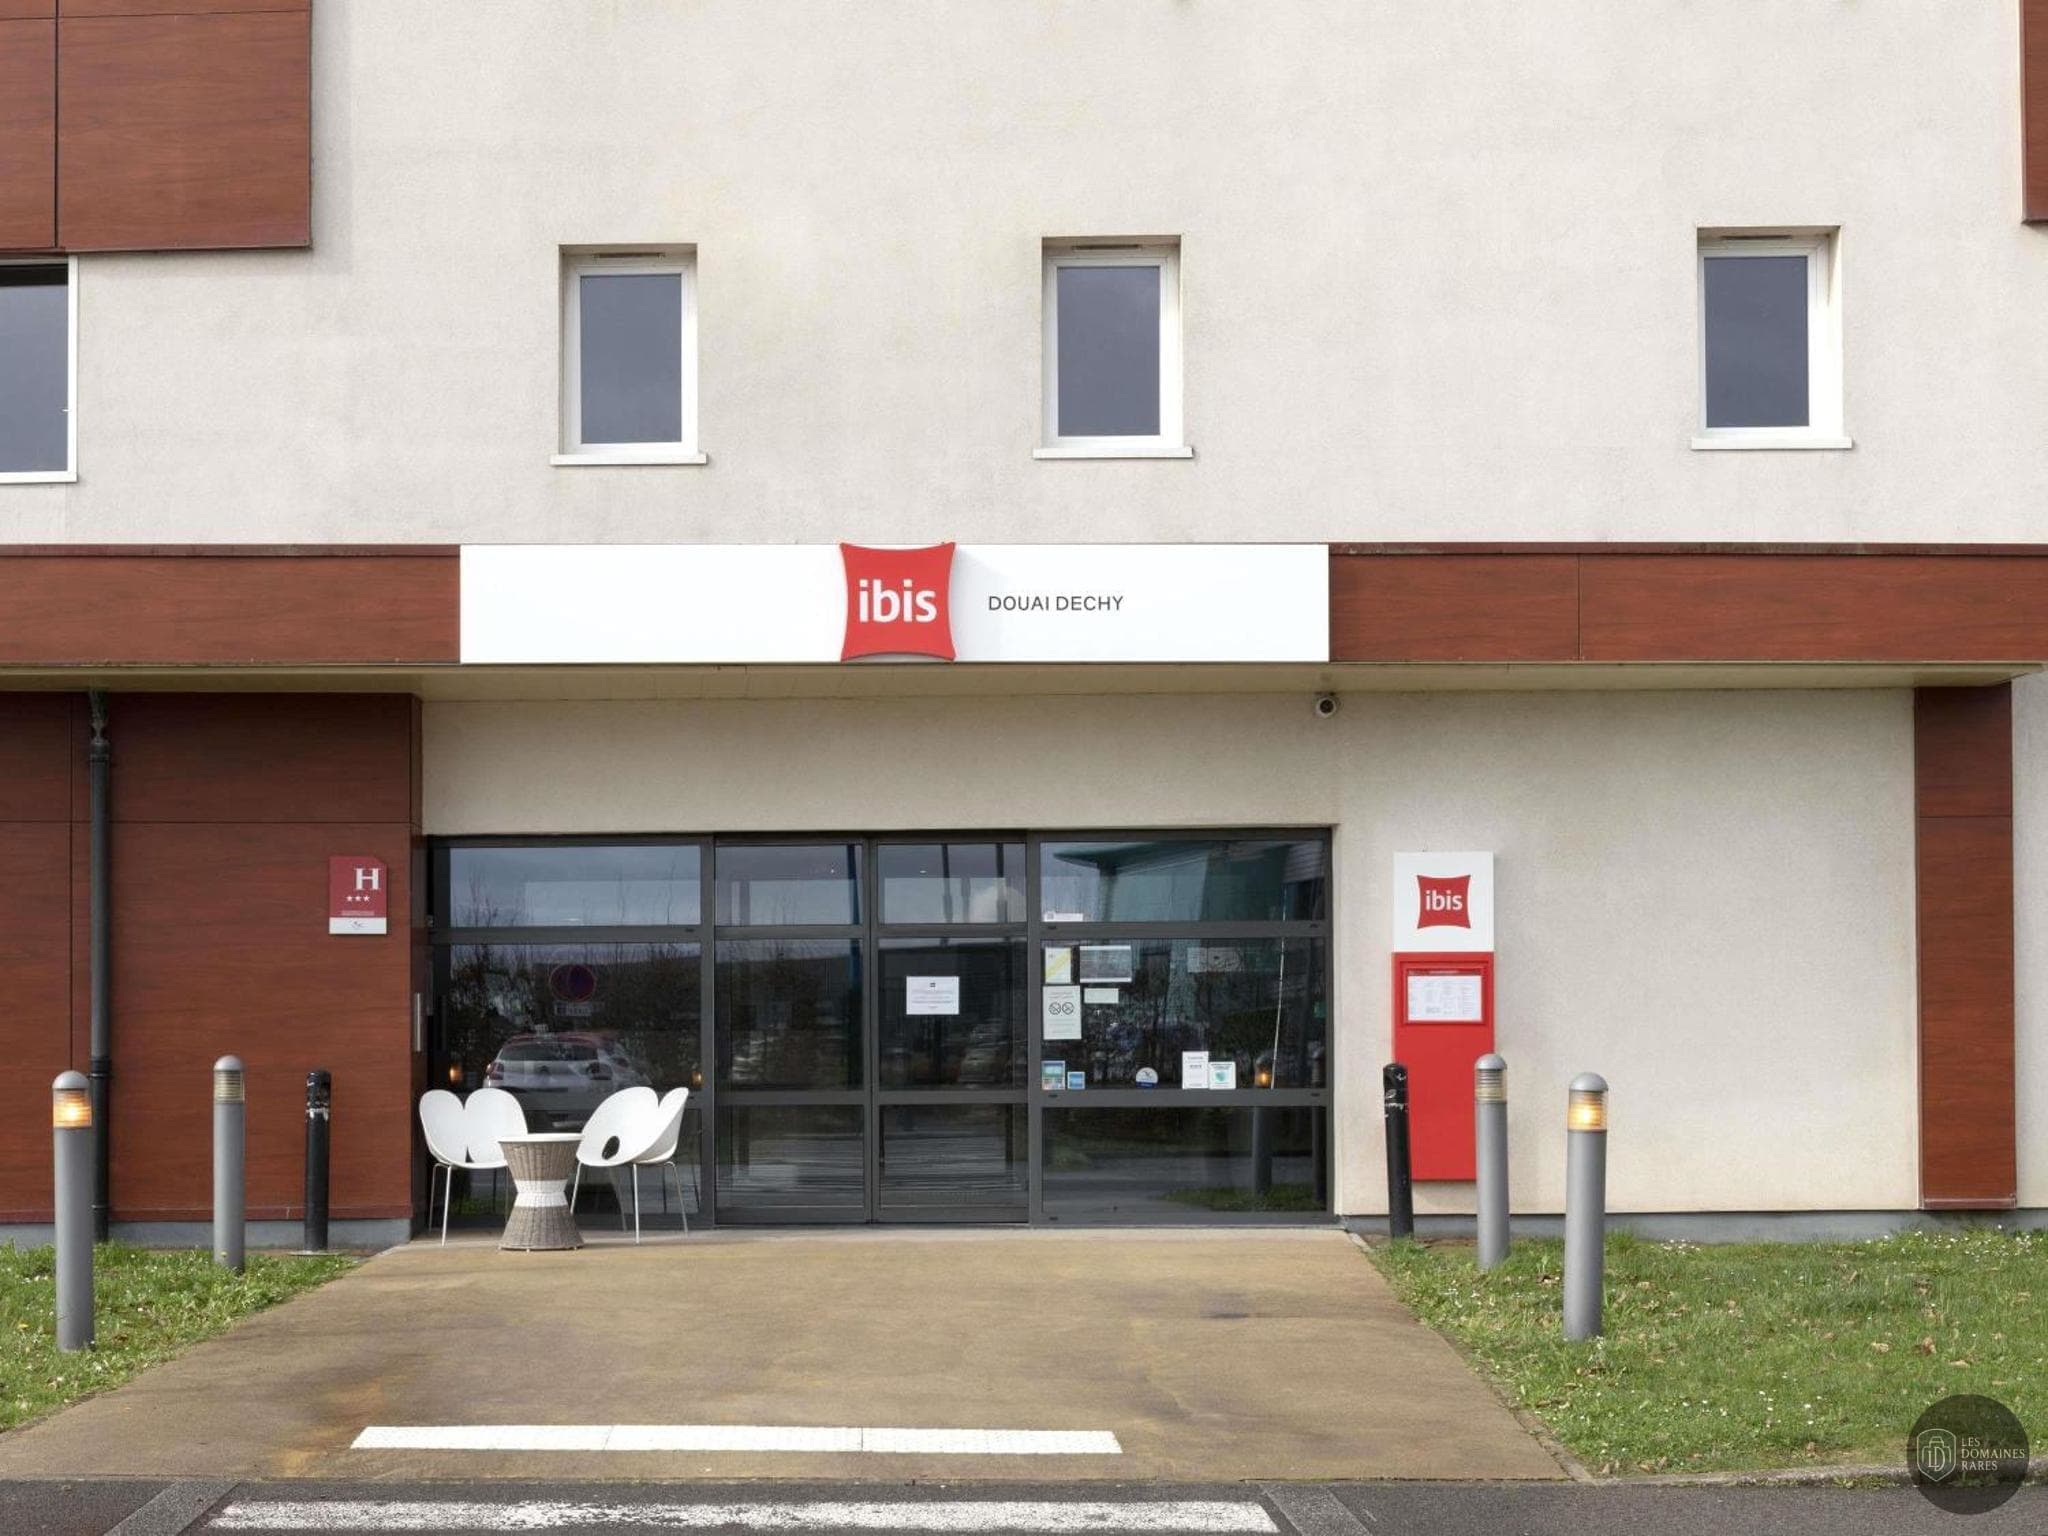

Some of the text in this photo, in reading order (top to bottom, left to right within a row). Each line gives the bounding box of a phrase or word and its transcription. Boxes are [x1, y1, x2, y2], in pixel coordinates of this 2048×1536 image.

[859, 578, 938, 623] ibis
[988, 595, 1124, 612] DOUAI DECHY
[355, 867, 380, 891] H
[1425, 889, 1463, 911] ibis
